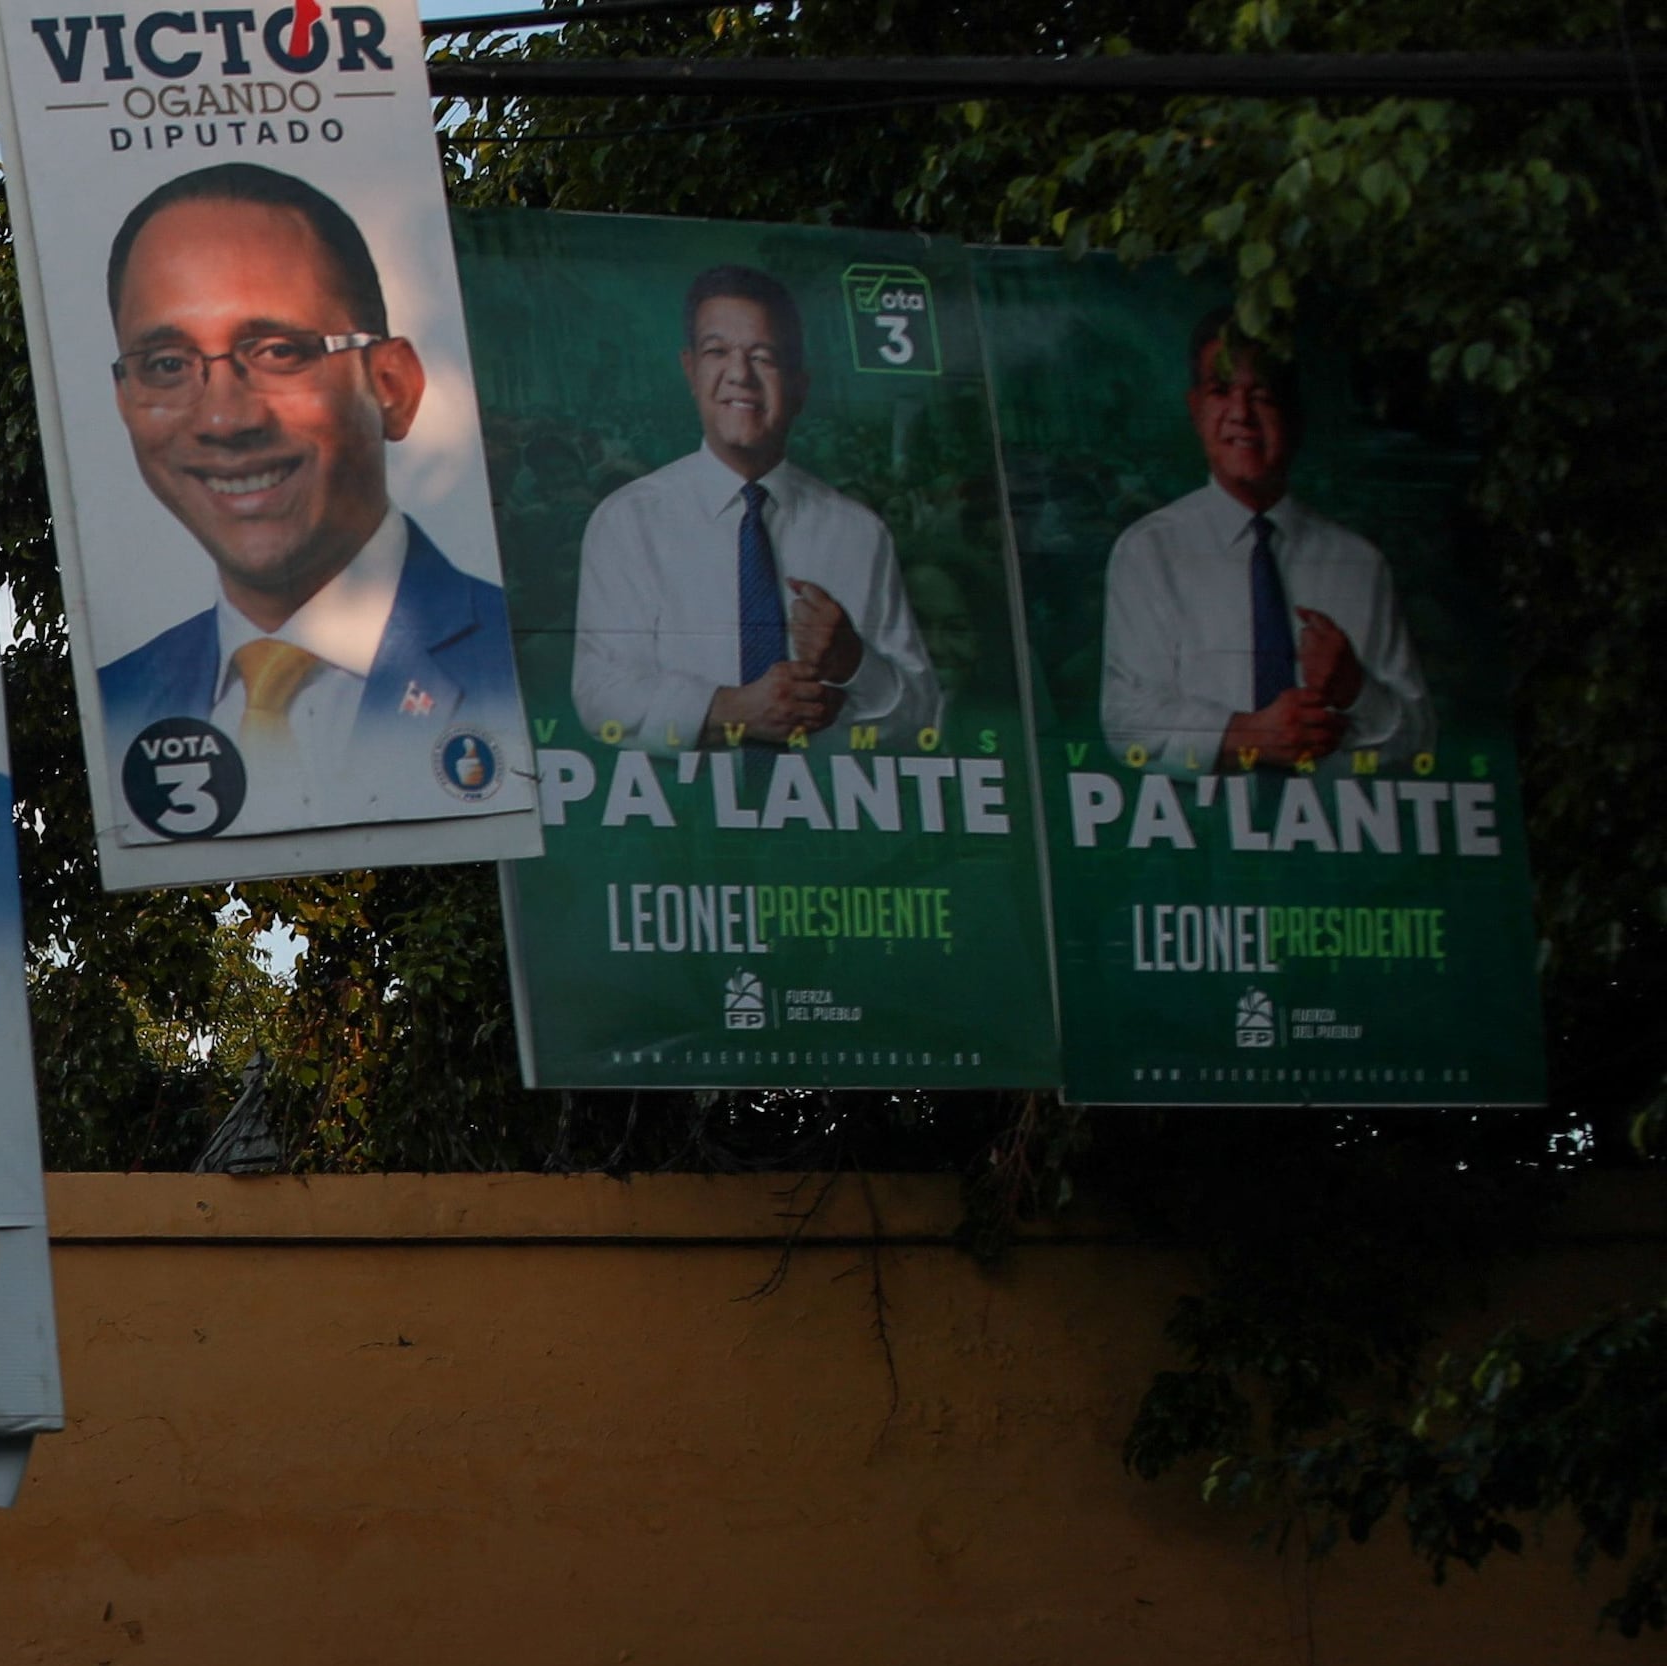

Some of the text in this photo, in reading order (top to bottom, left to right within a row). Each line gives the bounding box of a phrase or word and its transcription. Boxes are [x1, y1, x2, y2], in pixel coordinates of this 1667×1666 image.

[31, 5, 394, 83] VICTOR
[124, 80, 321, 119] OGANDO
[110, 118, 344, 151] DIPUTADO
[875, 315, 914, 365] 3
[139, 734, 221, 761] VOTA
[154, 763, 220, 834] 3
[534, 748, 1011, 835] PA'LANTE
[1069, 772, 1501, 856] PA'LANTE
[785, 990, 833, 1005] FUERZA
[787, 1007, 862, 1022] DEL PUEBLO
[729, 1013, 762, 1028] FP
